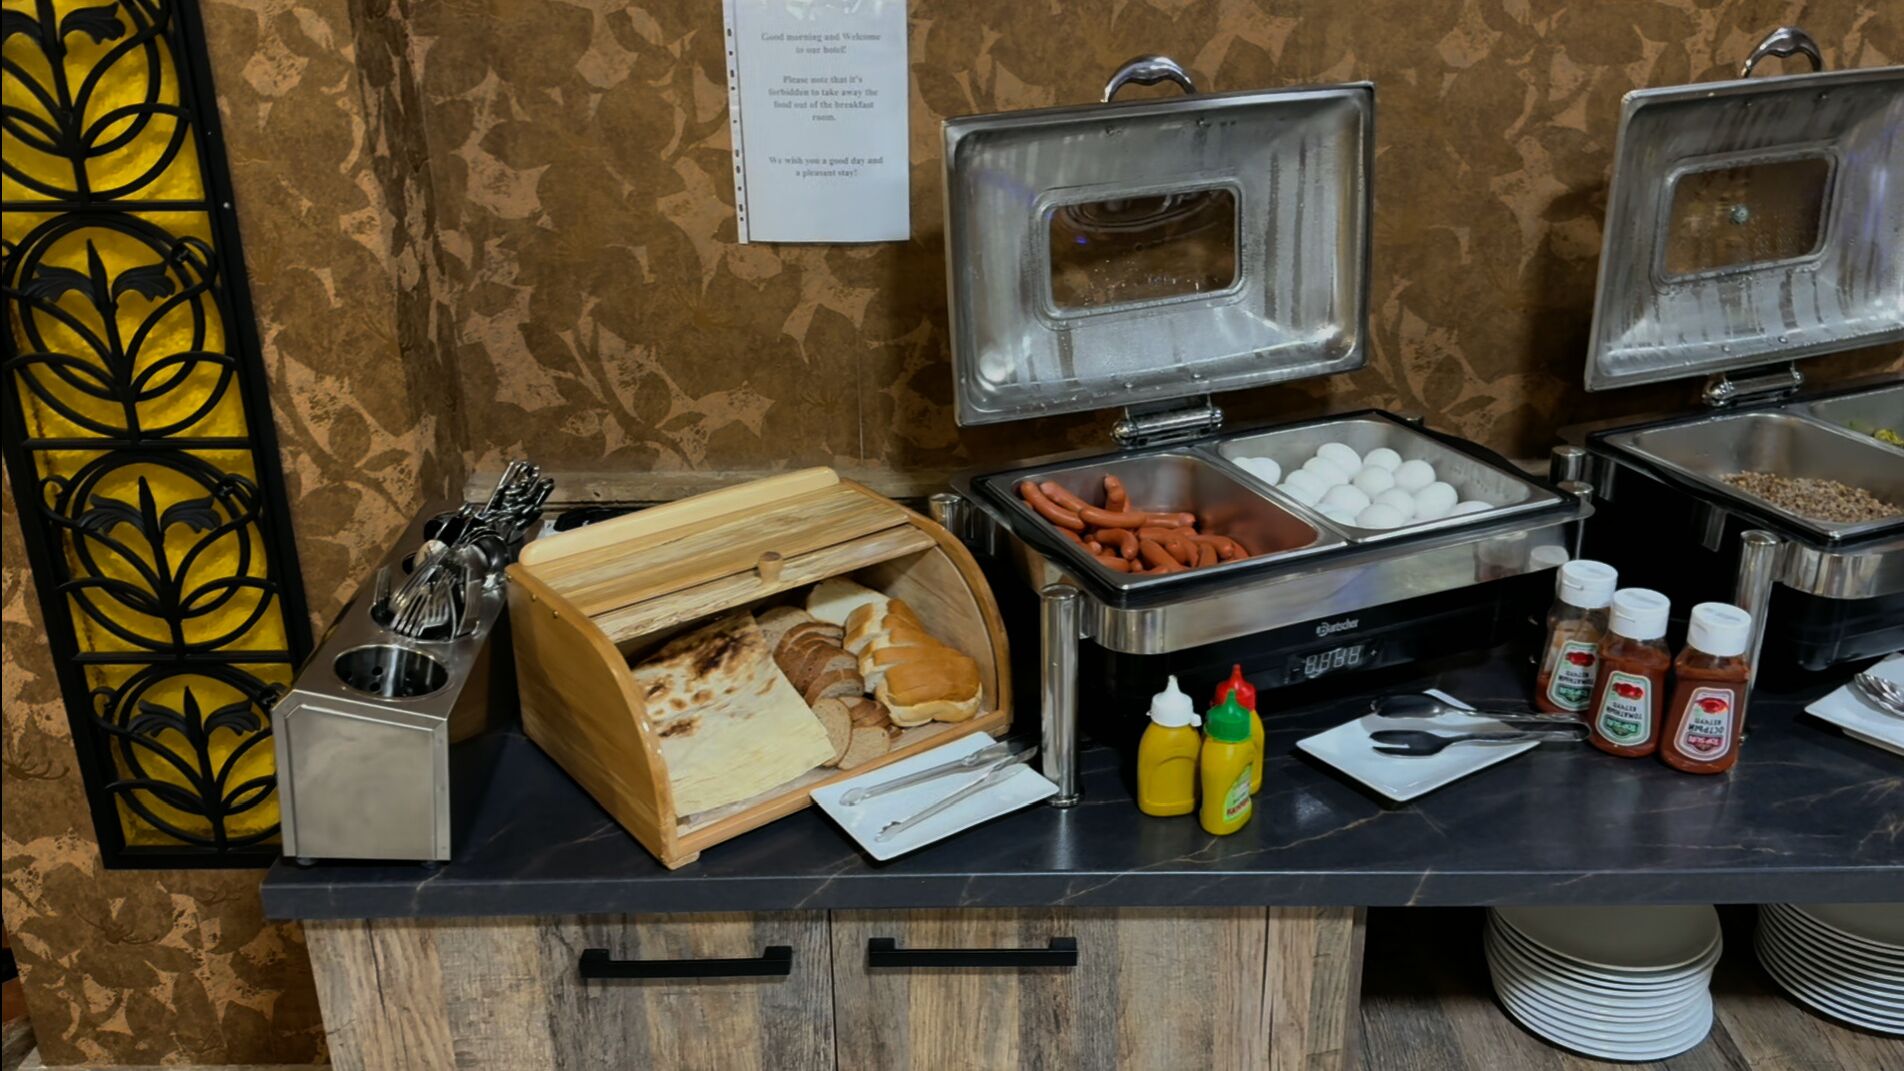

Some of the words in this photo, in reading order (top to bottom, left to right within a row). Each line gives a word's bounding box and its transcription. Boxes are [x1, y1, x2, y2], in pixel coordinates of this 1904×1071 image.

[761, 33, 784, 41] Good
[786, 33, 822, 42] morning
[824, 33, 840, 41] and
[842, 32, 881, 41] Welcome
[783, 75, 808, 84] Please
[831, 75, 847, 83] that
[849, 75, 863, 83] it's
[768, 88, 809, 97] forbidden
[821, 88, 838, 96] take
[841, 90, 862, 98] away
[865, 88, 878, 96] the
[774, 101, 792, 109] food
[810, 101, 818, 109] of
[820, 101, 832, 109] the
[835, 101, 874, 109] breakfast
[769, 156, 782, 164] We
[785, 156, 802, 164] wish
[805, 158, 820, 166] you
[829, 156, 849, 166] good
[851, 156, 865, 166] day
[867, 156, 883, 164] and
[802, 169, 836, 179] pleasant
